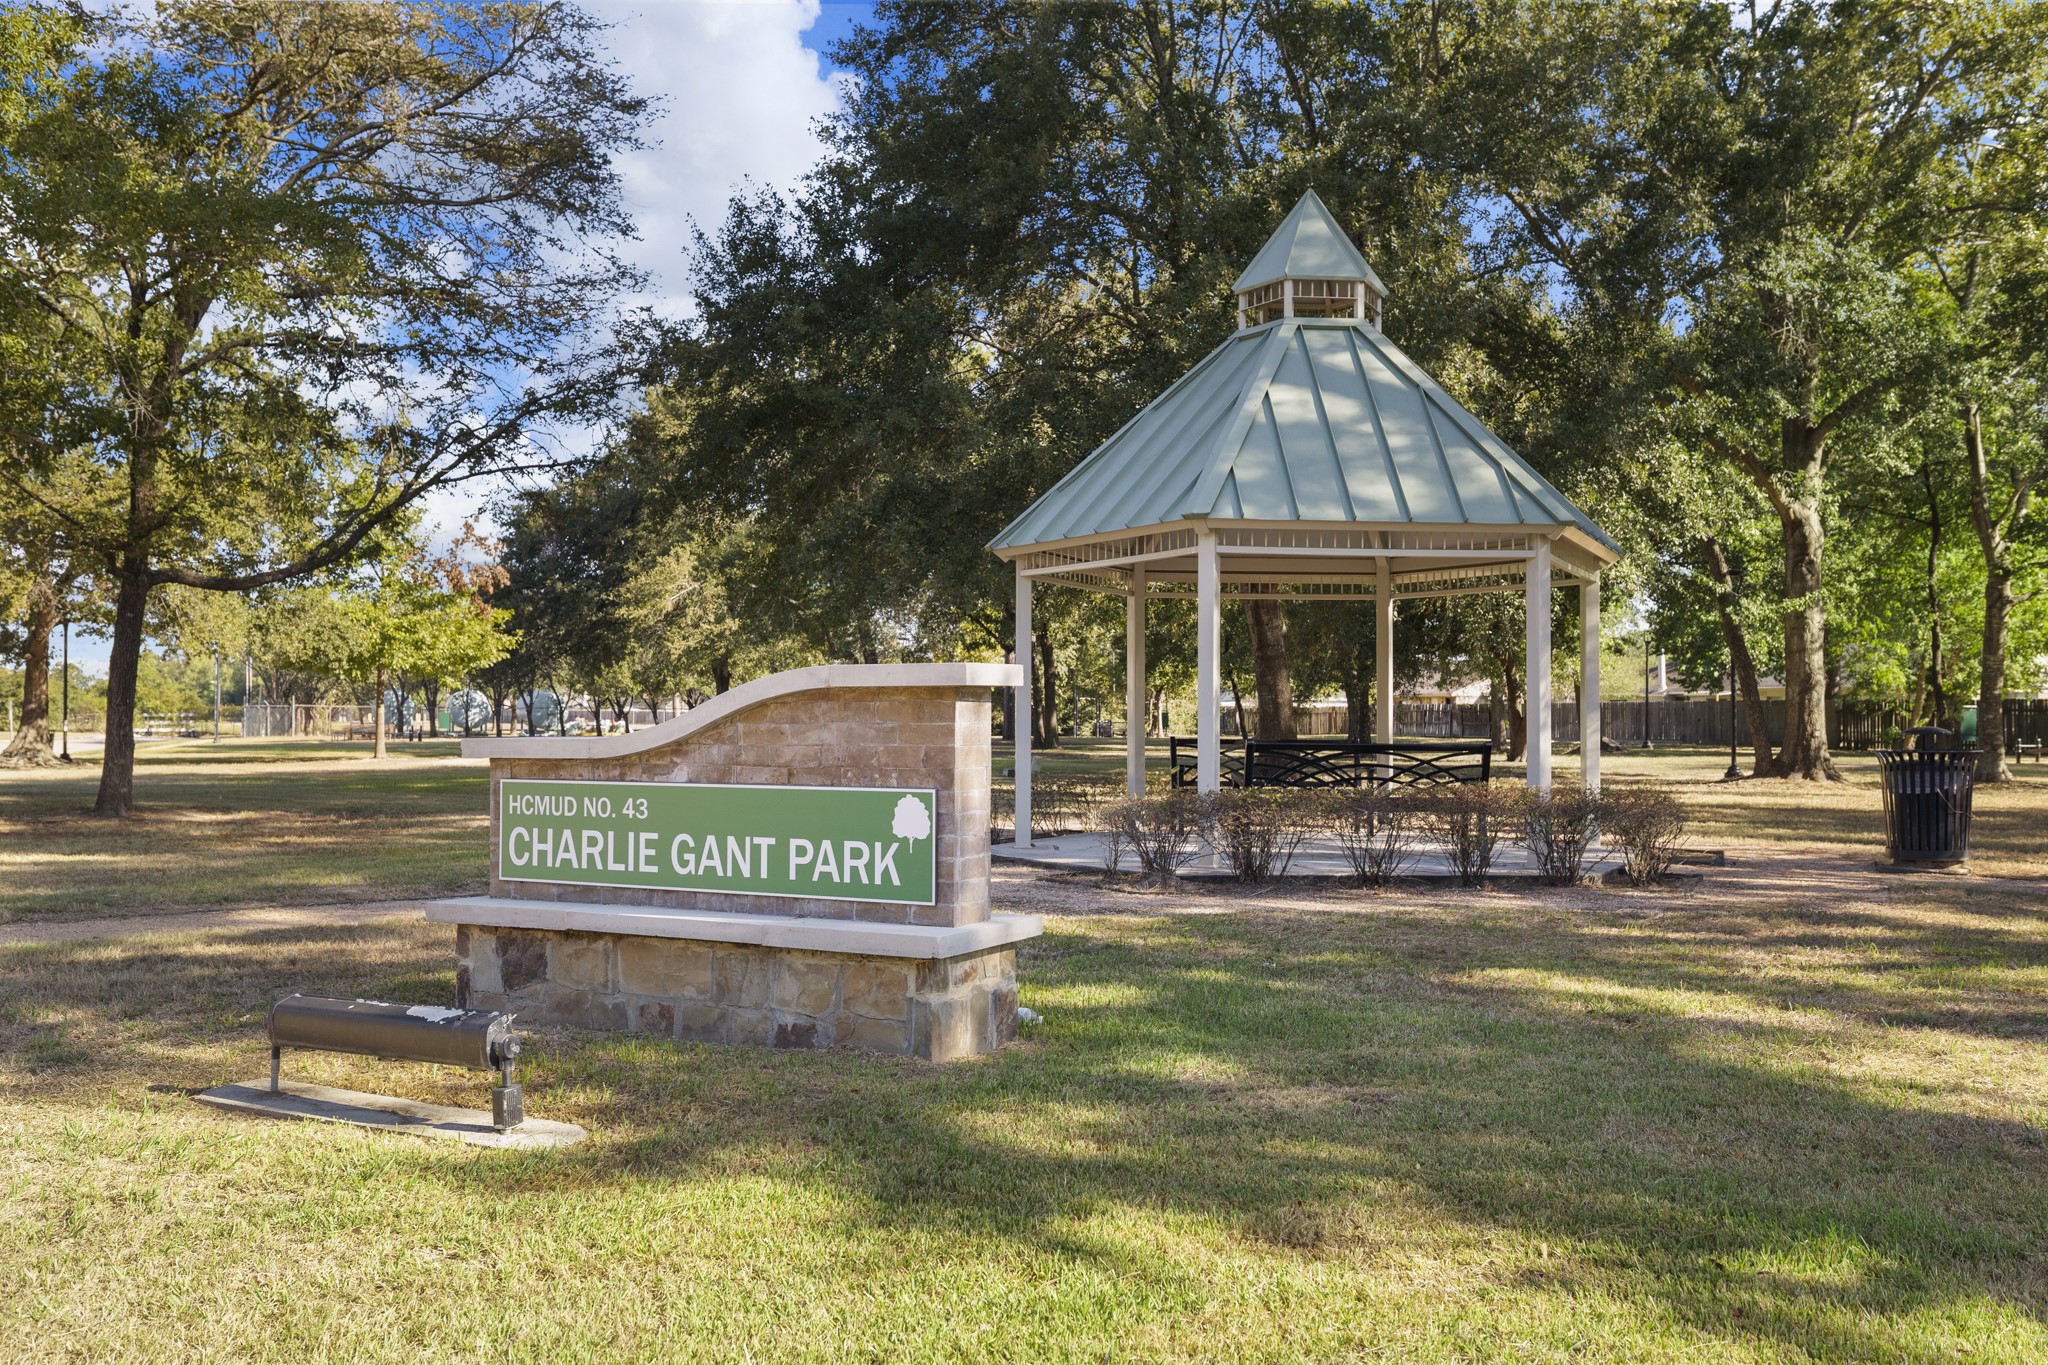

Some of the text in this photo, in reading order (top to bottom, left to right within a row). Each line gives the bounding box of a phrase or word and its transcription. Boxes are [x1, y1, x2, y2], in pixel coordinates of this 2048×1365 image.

[508, 794, 649, 820] HCMUD NO. 43
[508, 826, 901, 886] CHARLIE GANT PARK
